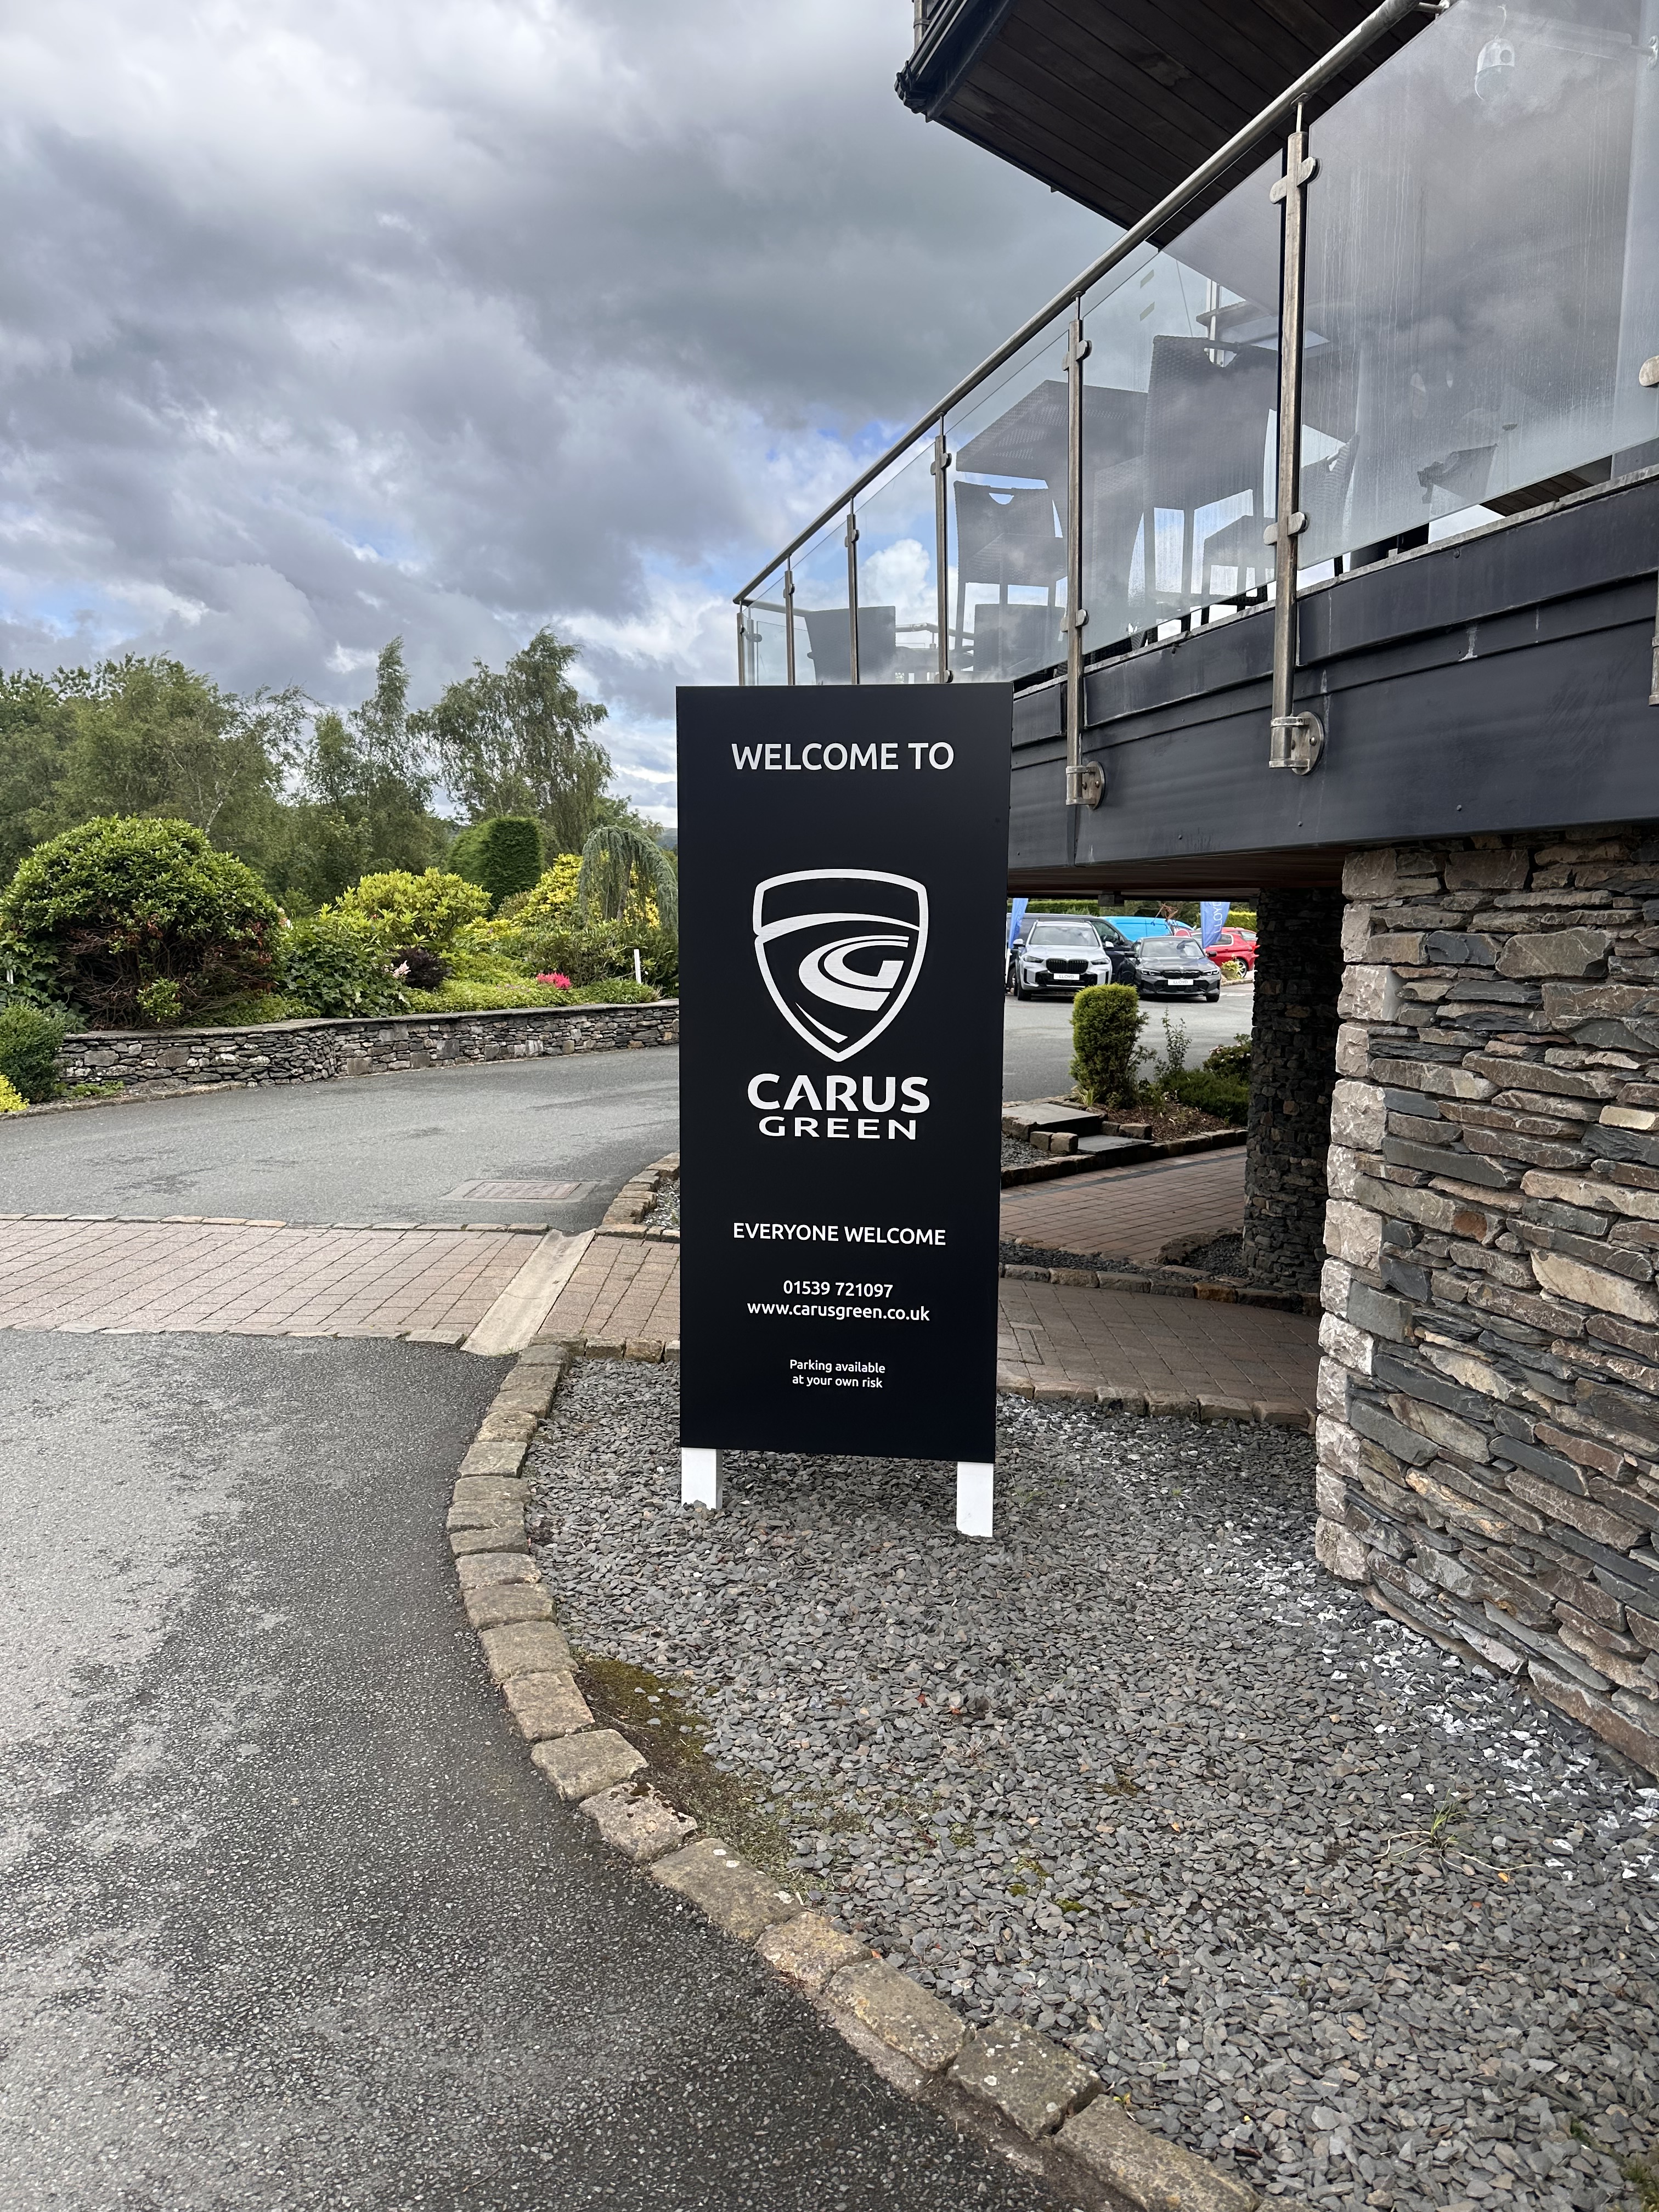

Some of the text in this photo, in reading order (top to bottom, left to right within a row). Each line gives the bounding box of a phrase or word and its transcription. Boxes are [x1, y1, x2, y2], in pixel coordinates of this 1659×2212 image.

[731, 742, 954, 770] WELCOME TO
[747, 1073, 930, 1114] CARUS
[759, 1116, 916, 1140] GREEN
[733, 1222, 946, 1245] EVERYONE WELCOME
[783, 1280, 893, 1298] 01539 721097
[747, 1303, 930, 1321] www.carusgreen.co.uk
[790, 1359, 885, 1374] Parking available
[792, 1375, 883, 1388] at your own risk
